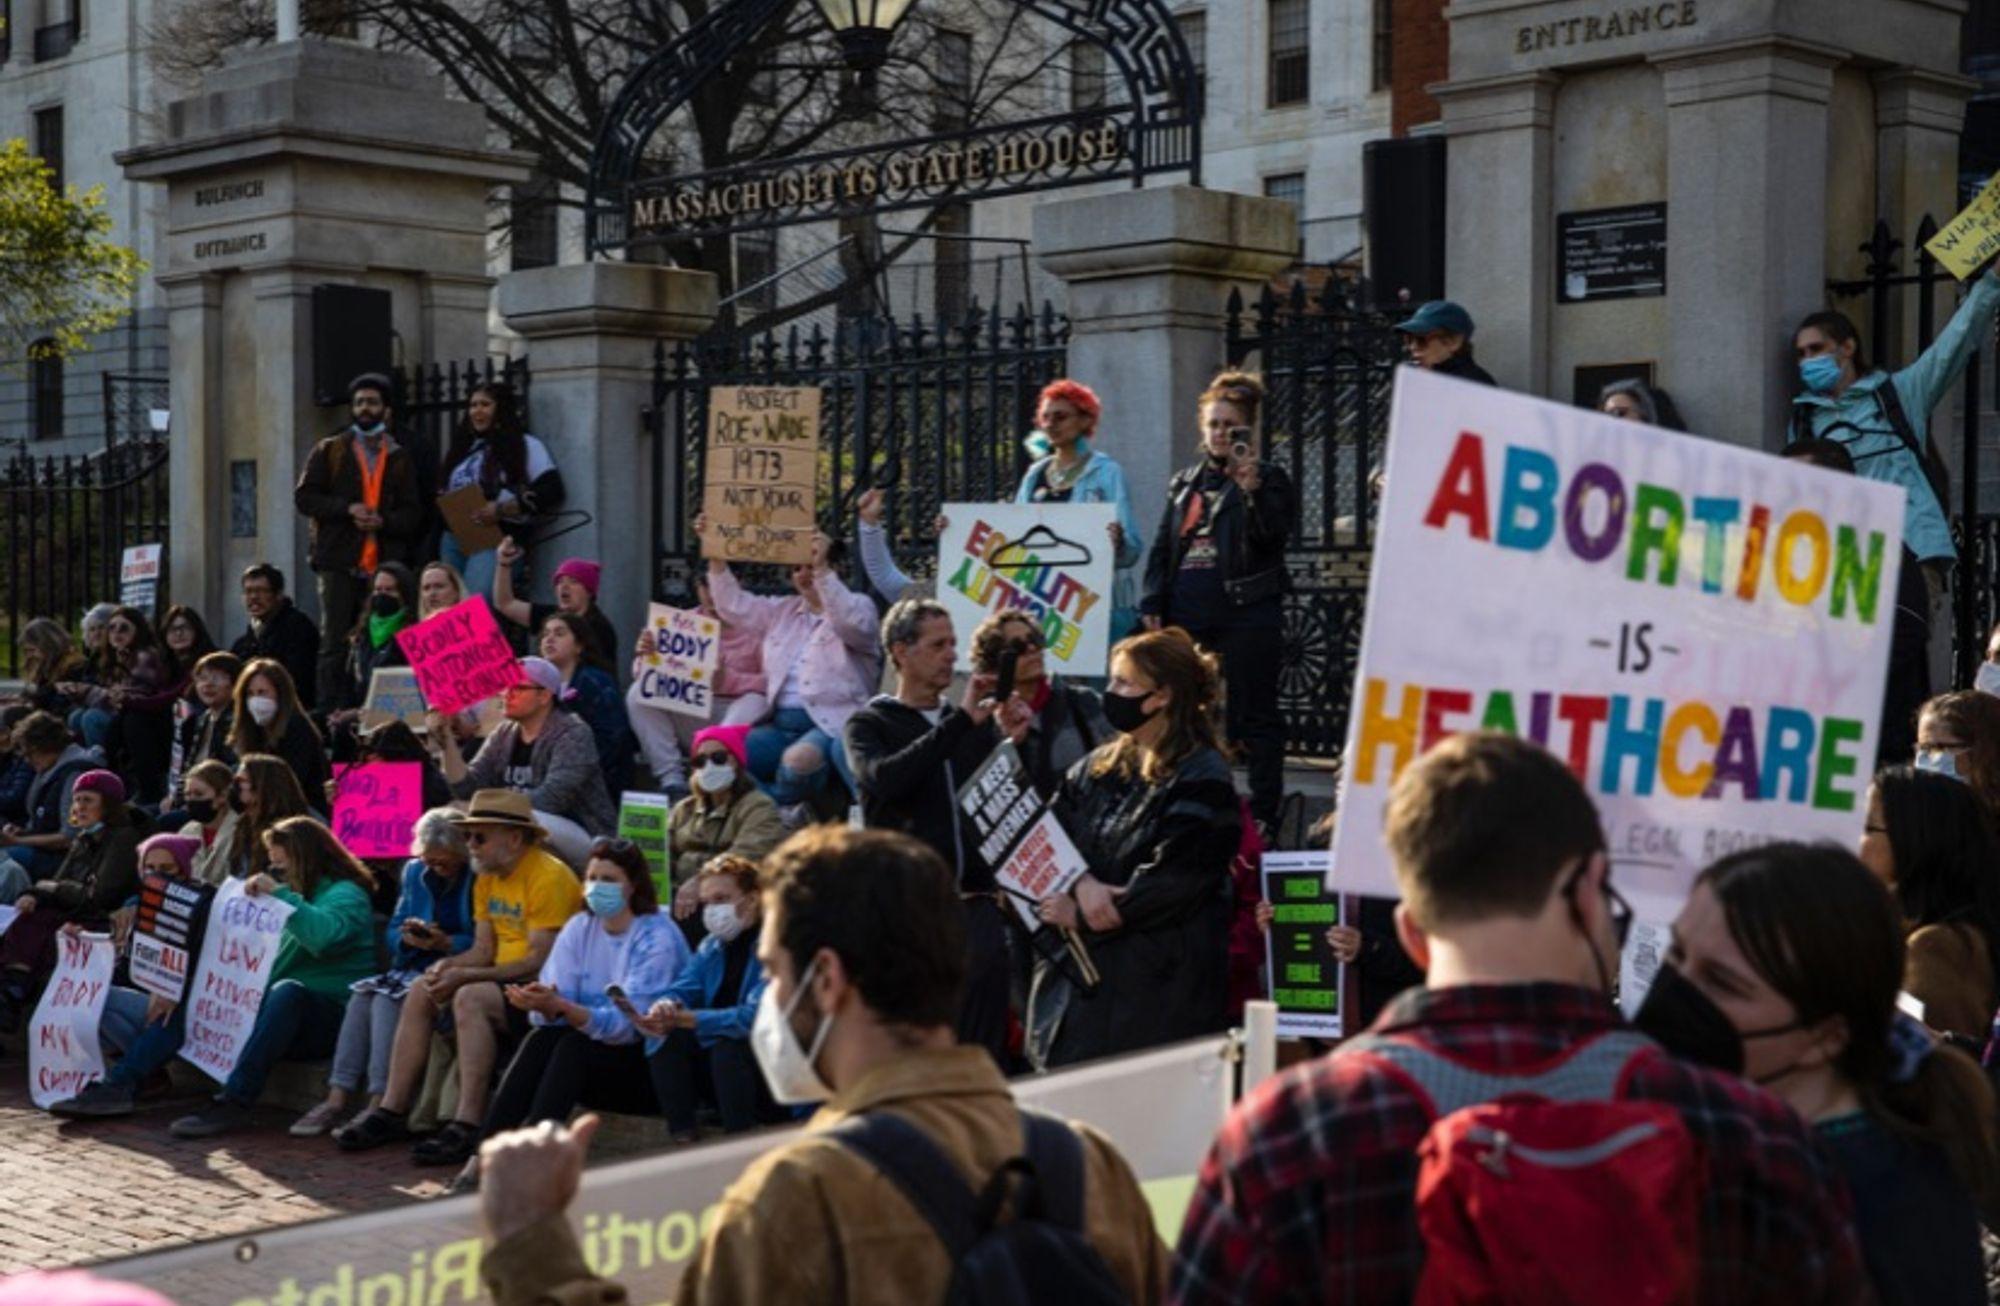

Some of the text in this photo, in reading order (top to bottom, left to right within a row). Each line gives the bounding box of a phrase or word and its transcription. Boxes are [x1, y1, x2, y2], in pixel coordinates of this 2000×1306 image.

[1514, 0, 1699, 55] ENTRANCE
[631, 125, 1120, 229] MASSACHUSETTS STATE HOUSE
[736, 387, 800, 411] PROTECT
[715, 411, 751, 444] ROE
[763, 413, 811, 442] WADE
[731, 449, 783, 481] 1973
[724, 488, 808, 513] NOT YOUR
[1422, 430, 1886, 624] ABORTION
[964, 519, 1101, 624] EQUALITY
[400, 611, 476, 663] BODILY
[657, 628, 714, 663] BODY
[641, 668, 710, 708] CHOICE
[979, 785, 1043, 866] MOVEMENT
[160, 946, 185, 976] ALL
[218, 930, 266, 974] LAW
[40, 1022, 71, 1057] MY
